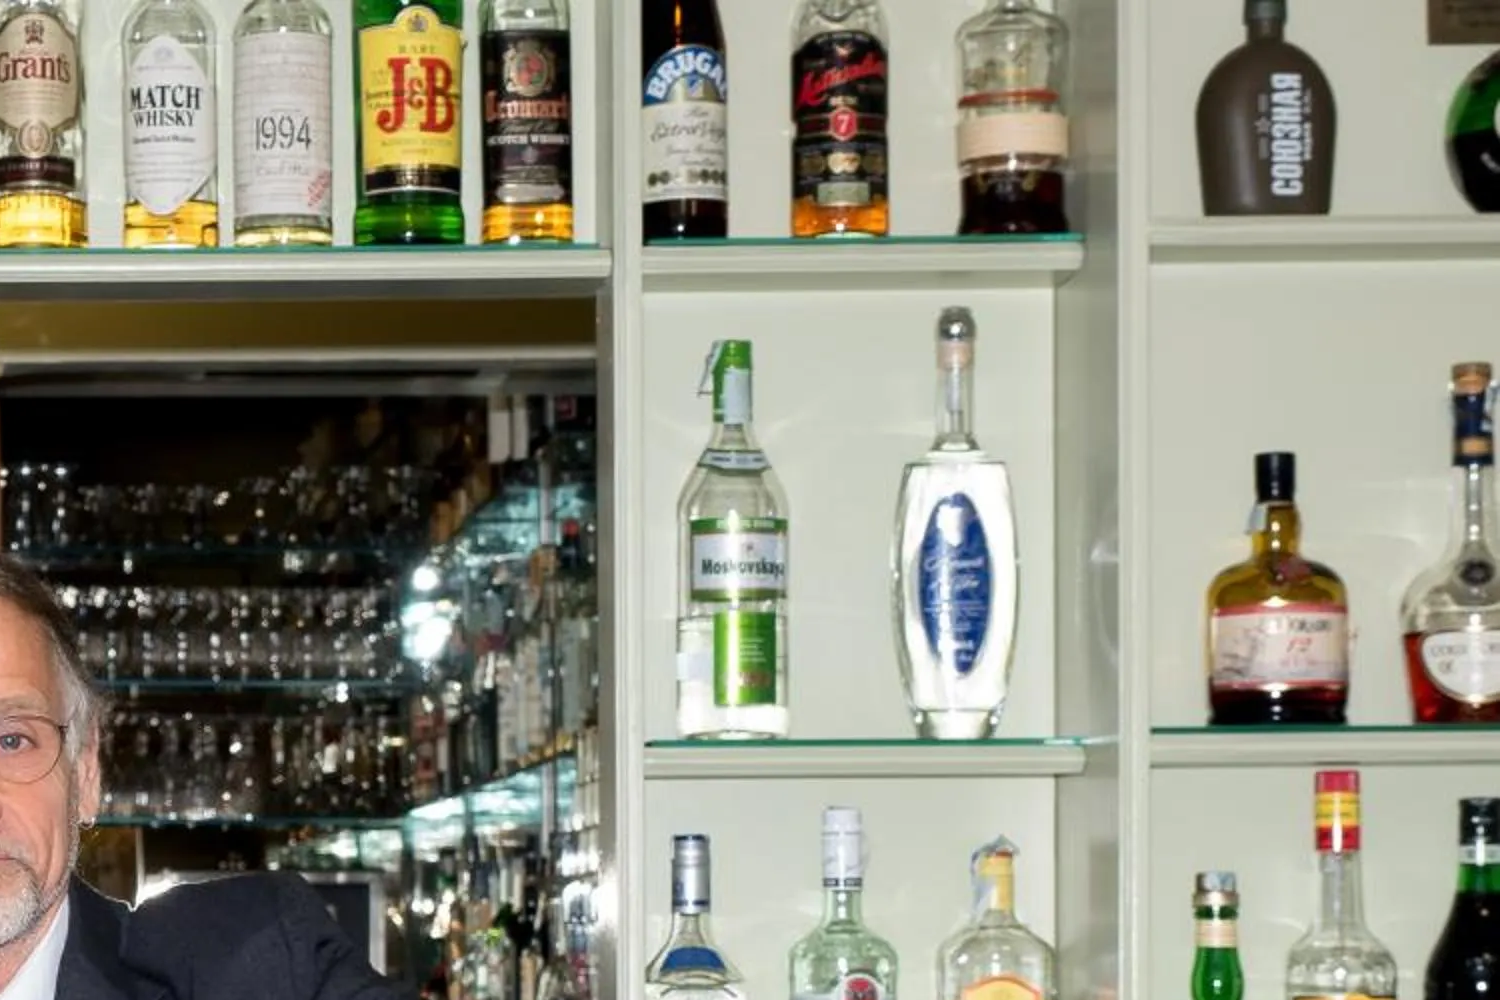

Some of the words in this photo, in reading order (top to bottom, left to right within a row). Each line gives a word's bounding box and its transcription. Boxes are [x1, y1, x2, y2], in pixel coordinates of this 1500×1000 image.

[130, 84, 201, 111] MATCH
[375, 56, 456, 135] J&B
[133, 109, 196, 128] WHISKY
[836, 114, 851, 134] 7
[255, 114, 312, 151] 1994
[702, 556, 785, 582] Mosovskaya
